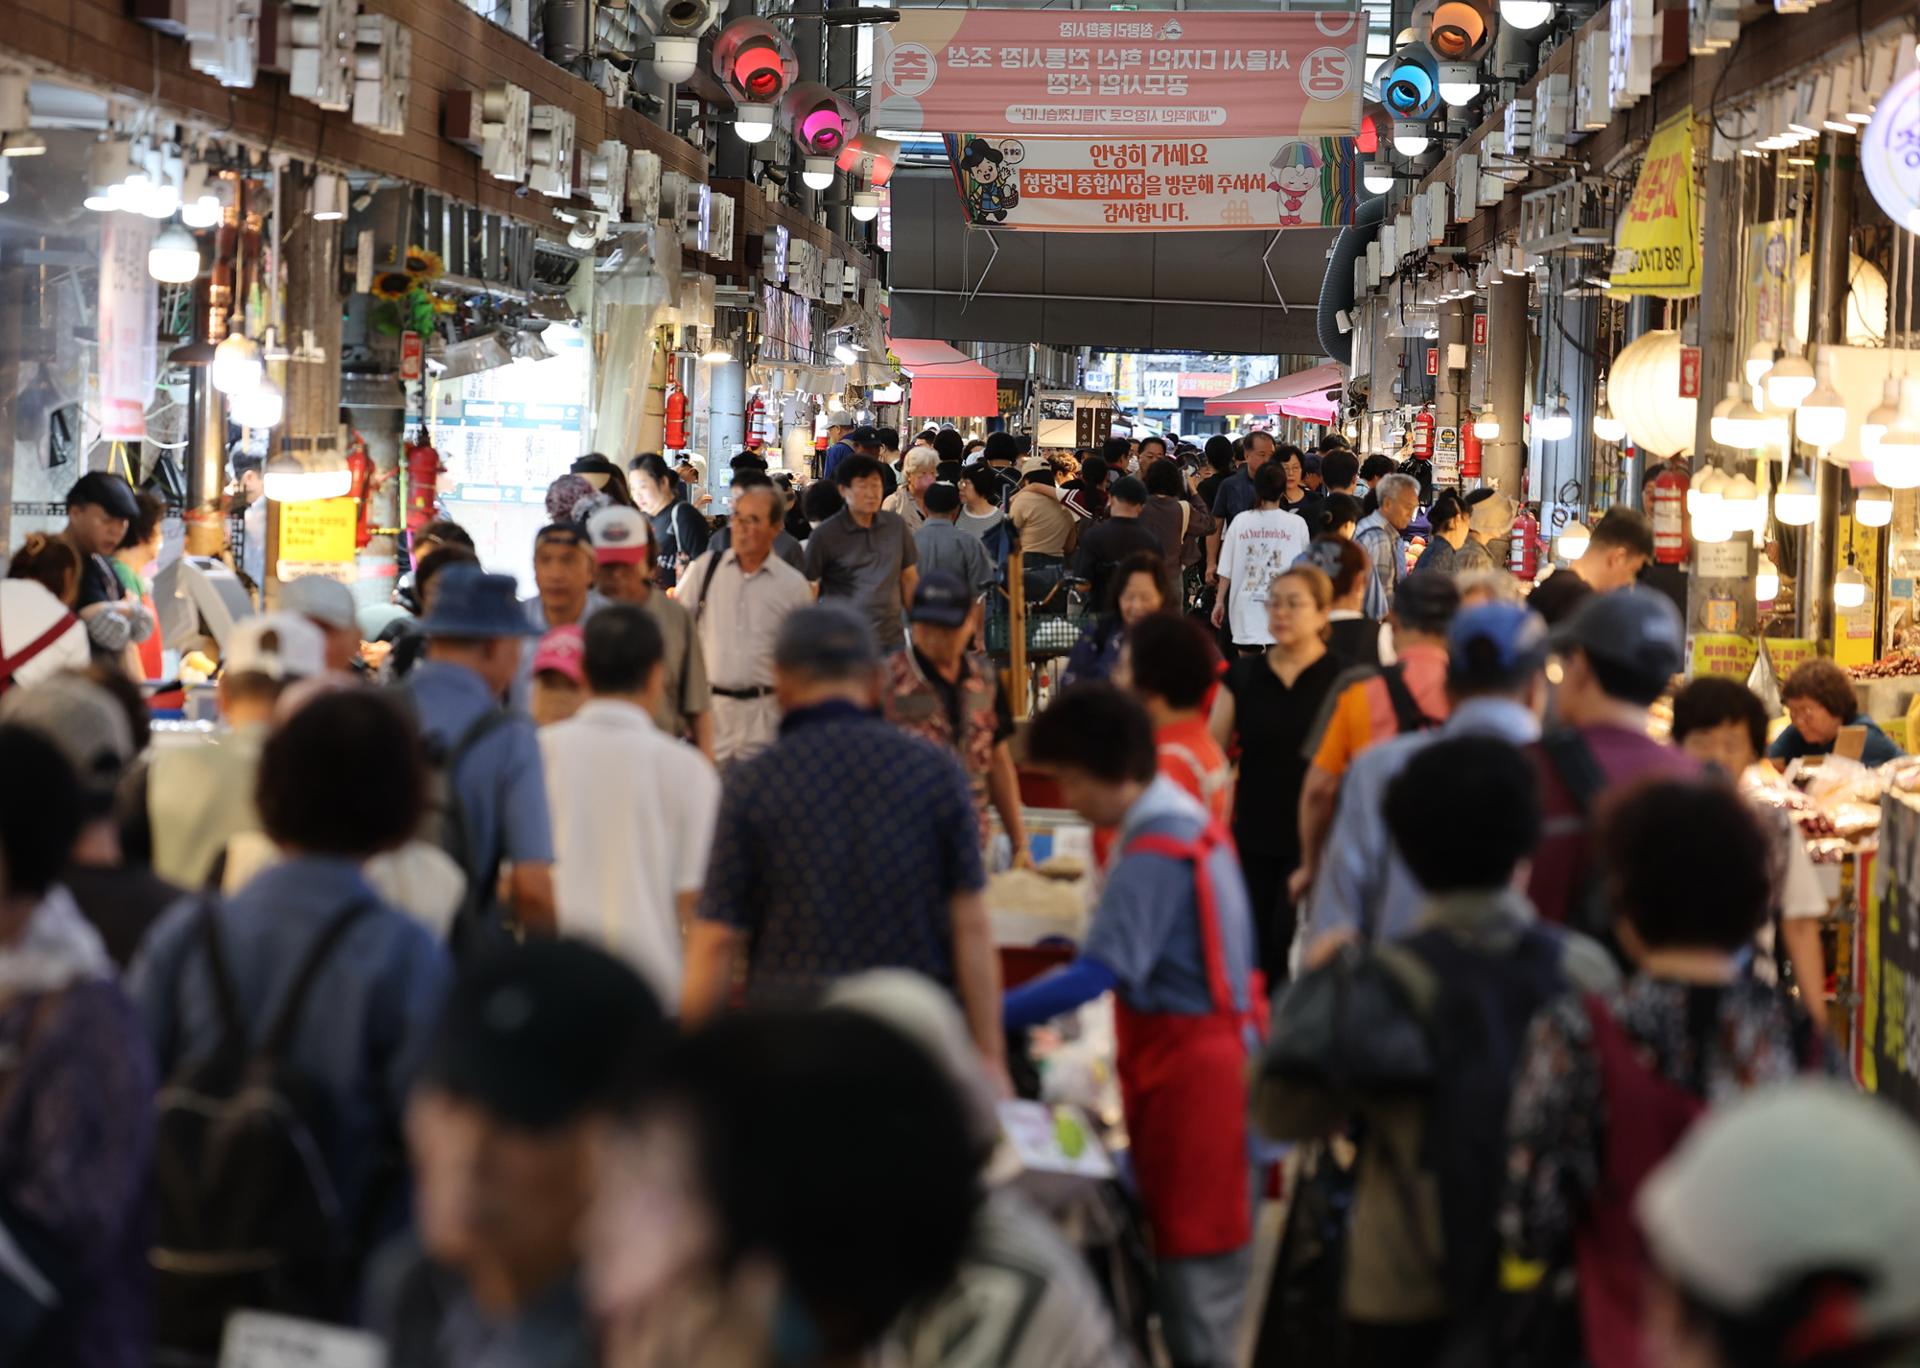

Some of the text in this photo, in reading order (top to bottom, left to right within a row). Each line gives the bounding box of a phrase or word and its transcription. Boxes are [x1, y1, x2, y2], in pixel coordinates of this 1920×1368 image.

[1089, 143, 1208, 169] 안녕히 가세요
[1023, 173, 1266, 196] 청량리 종합시장을 방문해 주셔서
[1103, 202, 1189, 224] 감사합니다.
